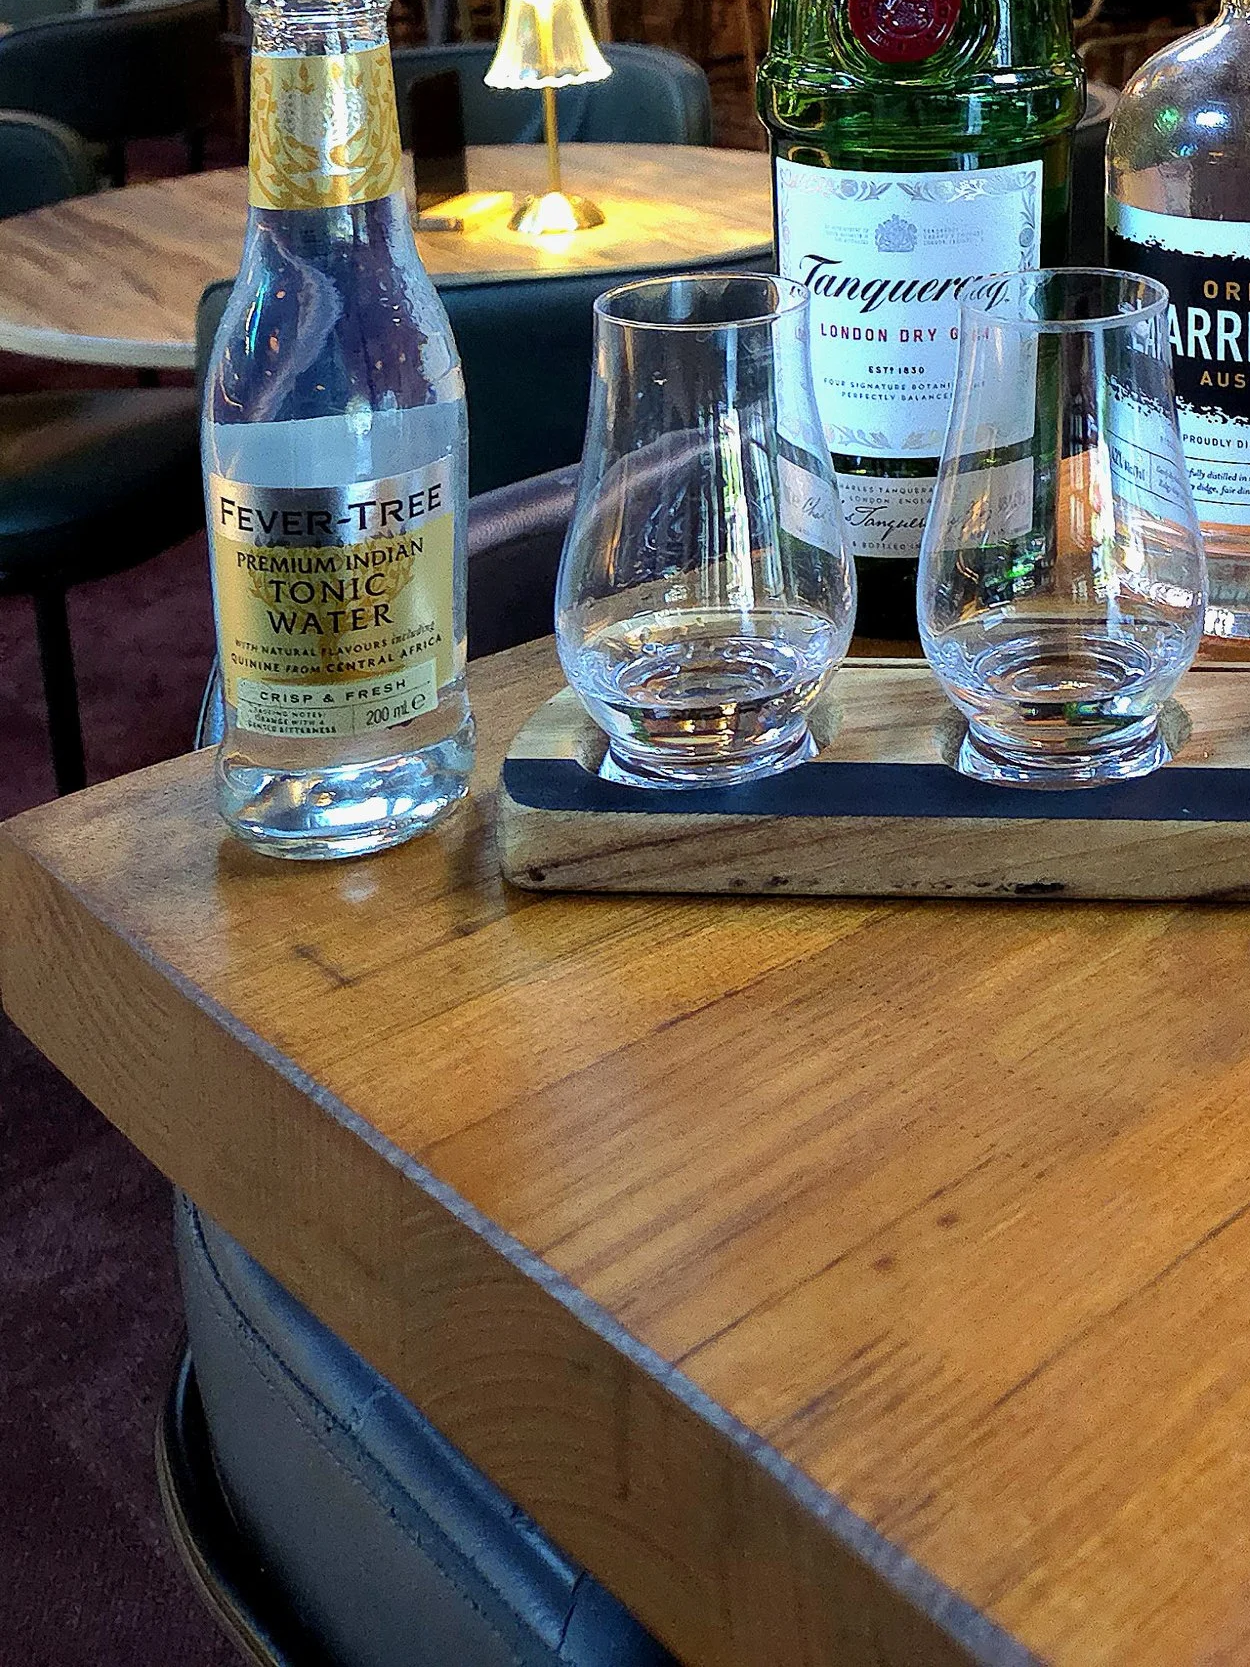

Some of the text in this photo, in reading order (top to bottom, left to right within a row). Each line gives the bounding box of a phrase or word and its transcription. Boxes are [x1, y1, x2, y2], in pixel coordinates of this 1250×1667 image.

[820, 323, 887, 342] LONDON
[900, 328, 938, 343] DRY
[898, 365, 925, 375] 1830
[901, 392, 953, 402] BALANCE
[1182, 433, 1232, 447] PROUDLY
[1207, 471, 1238, 483] distilled
[1239, 472, 1247, 482] in
[878, 486, 933, 495] TANQUERA
[1219, 485, 1236, 497] fair
[220, 482, 442, 537] FEVER-TREE
[898, 497, 932, 505] ENGLA
[237, 537, 425, 574] PREMIUM INDIAN
[268, 573, 386, 604] TONIC
[266, 604, 394, 636] WATER
[234, 621, 436, 658] WITH NATURAL FLAVOURS including
[230, 633, 443, 674] QUININE FROM CENTRAL AFRICA
[260, 679, 406, 704] CRISP & FRESH
[366, 707, 390, 726] 200
